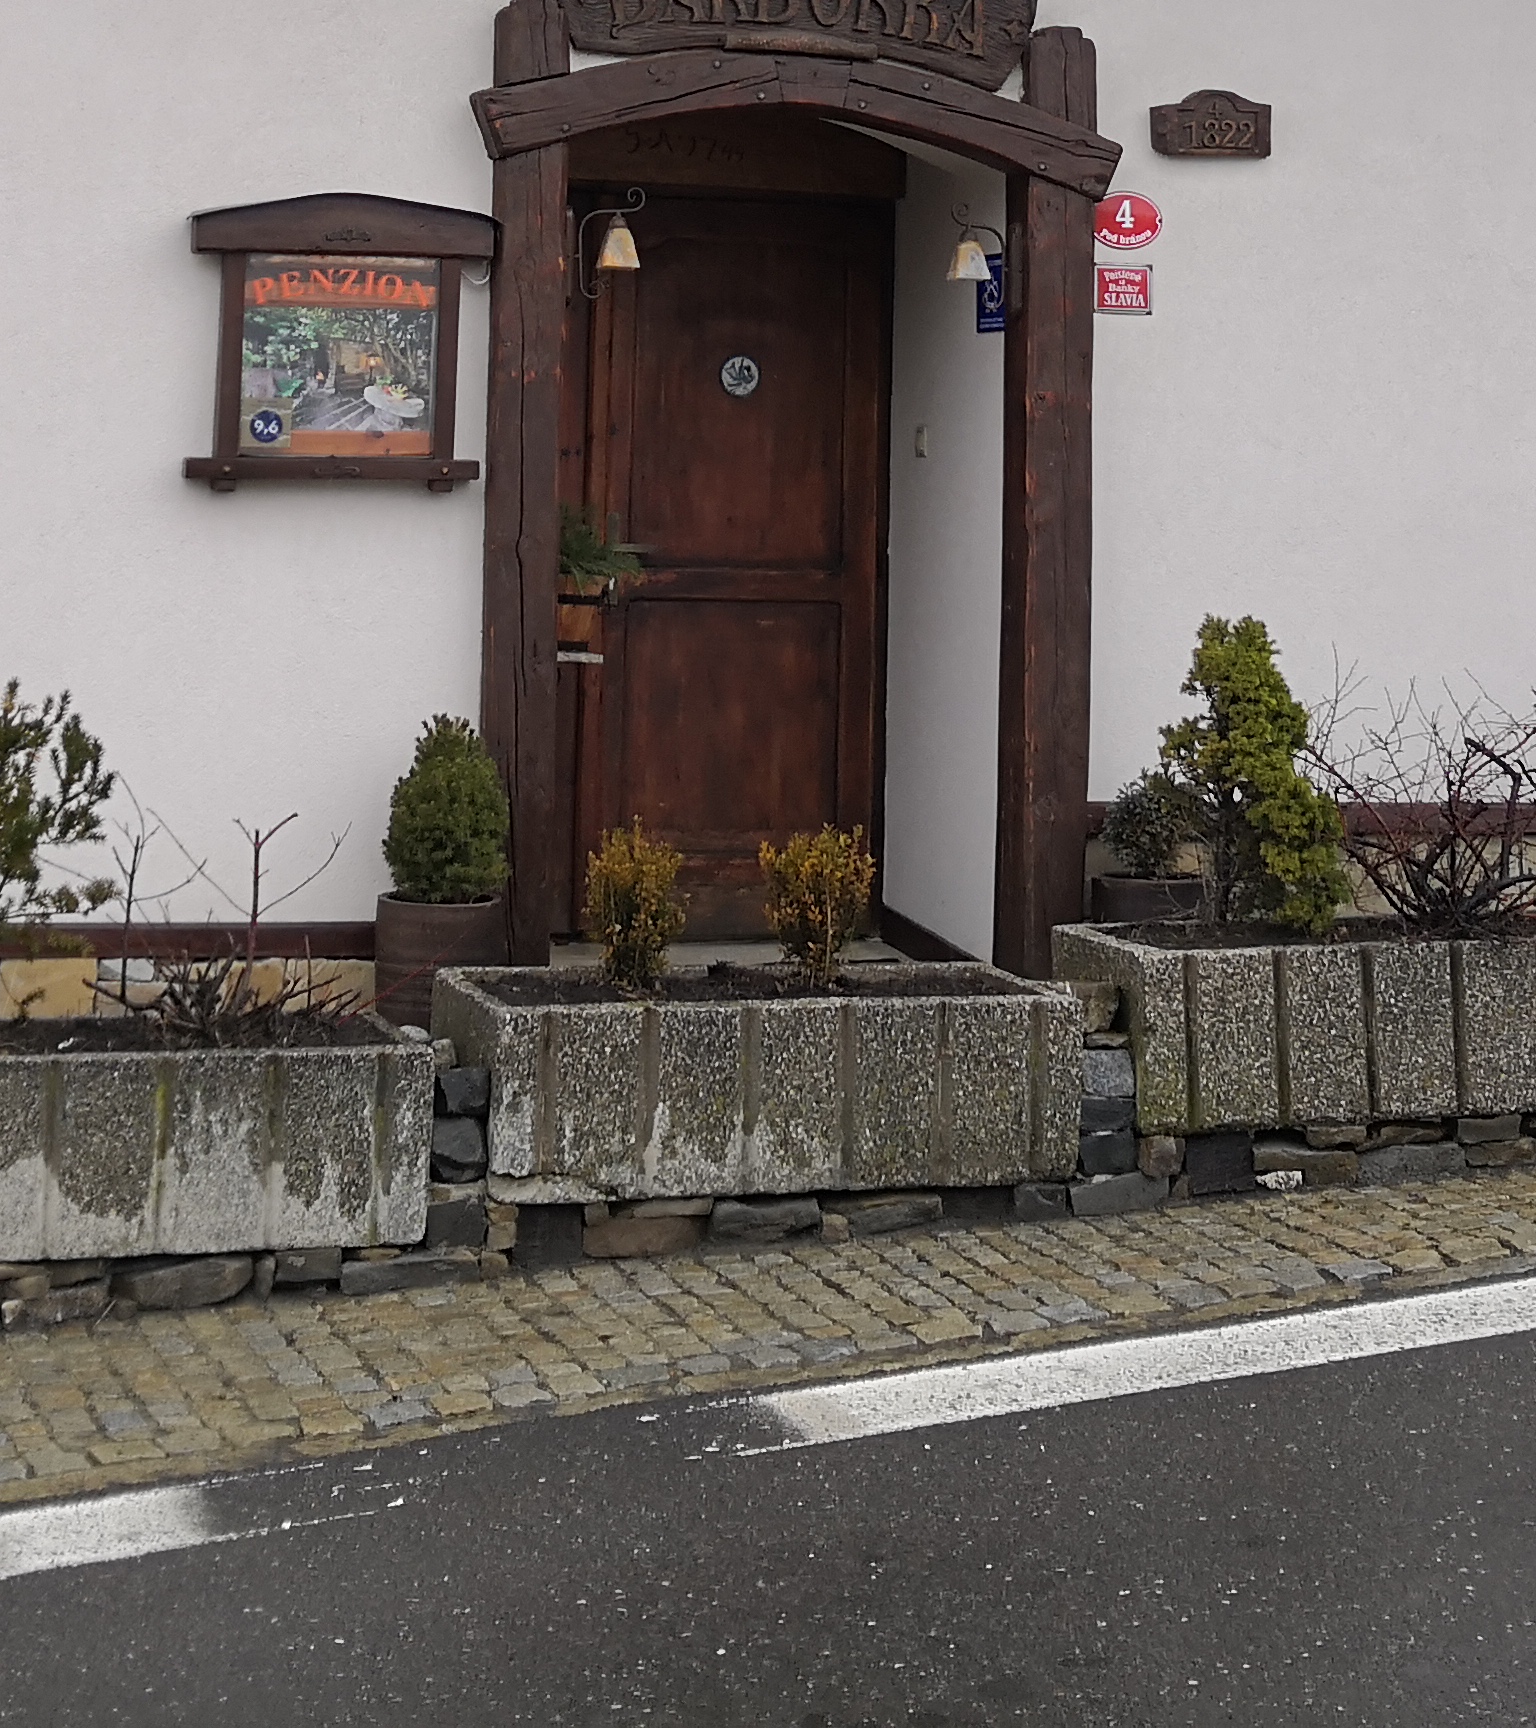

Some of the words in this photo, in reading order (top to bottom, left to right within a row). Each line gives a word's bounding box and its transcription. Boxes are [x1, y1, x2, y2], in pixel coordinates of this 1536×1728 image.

[1182, 119, 1255, 148] 1822
[1115, 199, 1135, 228] 4
[1099, 228, 1118, 243] Pod
[252, 267, 437, 310] PENZION
[1108, 283, 1140, 293] Banky
[1103, 292, 1145, 307] SLAVIA
[254, 419, 279, 435] 9,6
